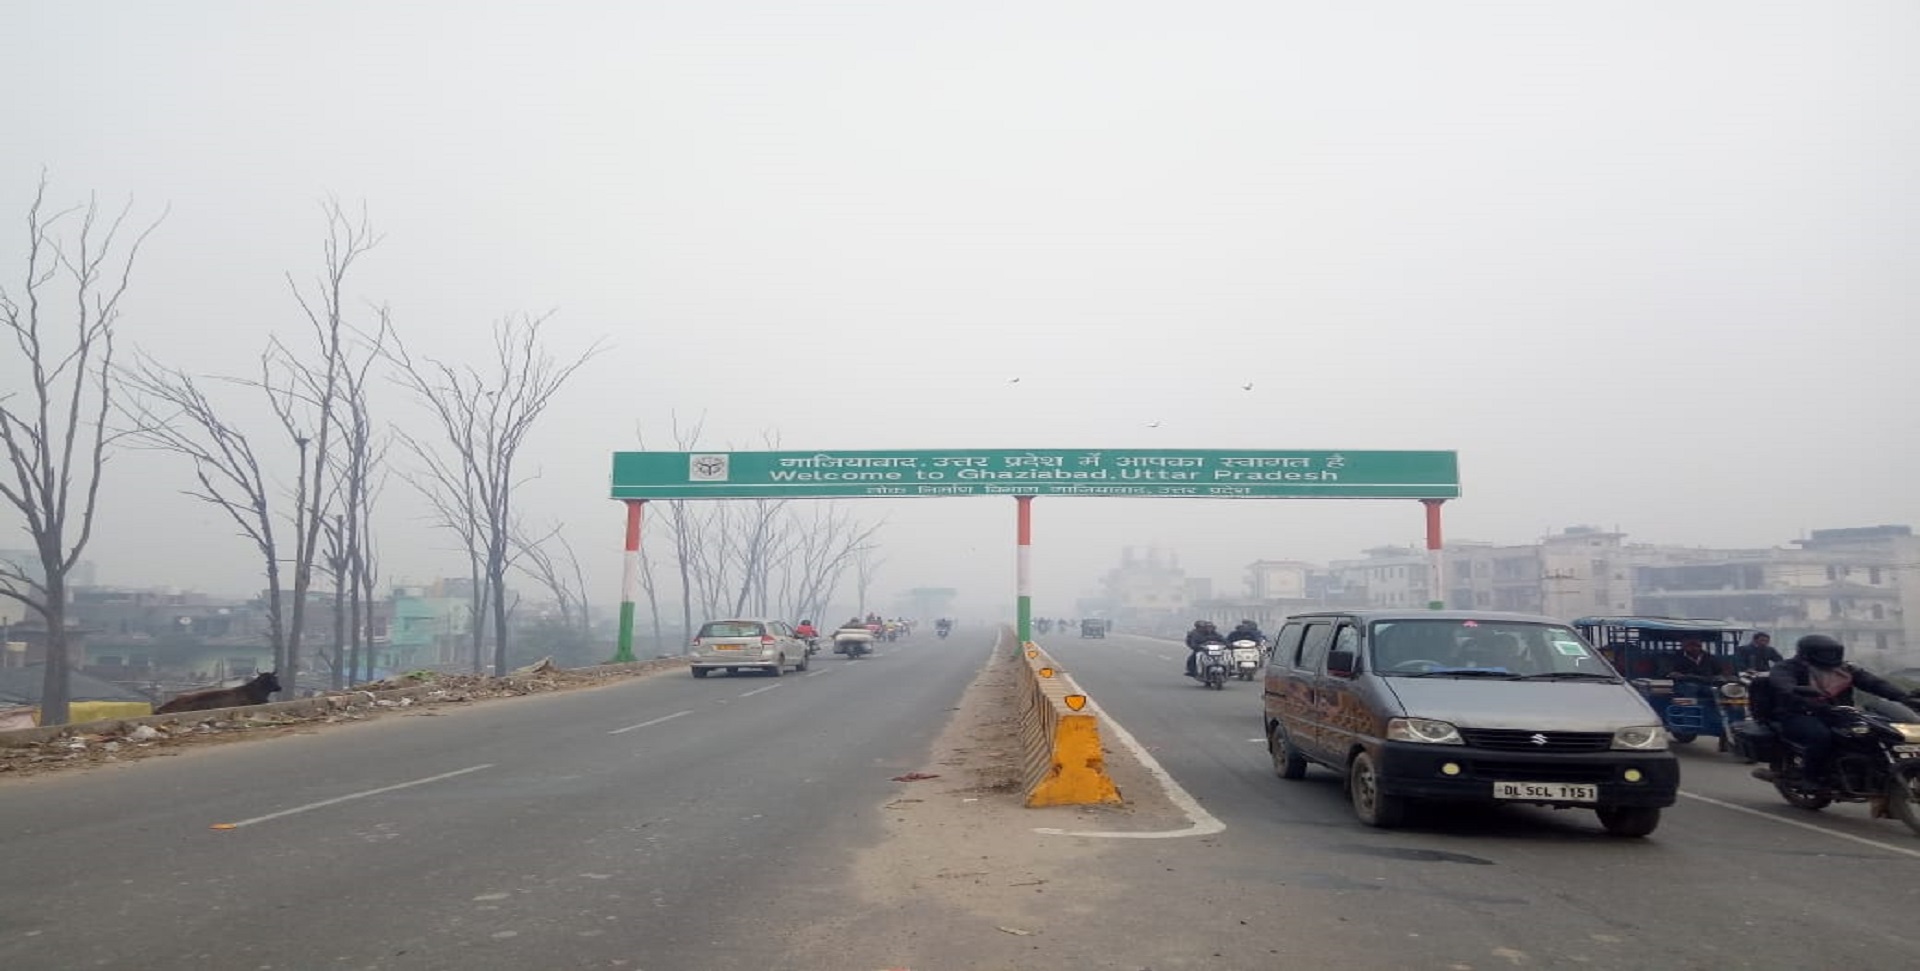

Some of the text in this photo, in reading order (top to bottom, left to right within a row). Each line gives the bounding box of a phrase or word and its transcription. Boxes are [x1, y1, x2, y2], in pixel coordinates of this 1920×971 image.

[1004, 453, 1064, 468] प्रदेश
[1078, 453, 1100, 467] में
[1116, 457, 1203, 467] आपका
[1220, 457, 1310, 468] स्वागत
[1326, 453, 1345, 468] है
[769, 470, 902, 481] Welcome
[917, 470, 943, 480] to
[1214, 470, 1338, 480] Pradesh
[1211, 485, 1250, 494] प्रदेश
[1505, 785, 1521, 795] DL
[1560, 787, 1594, 798] 1151
